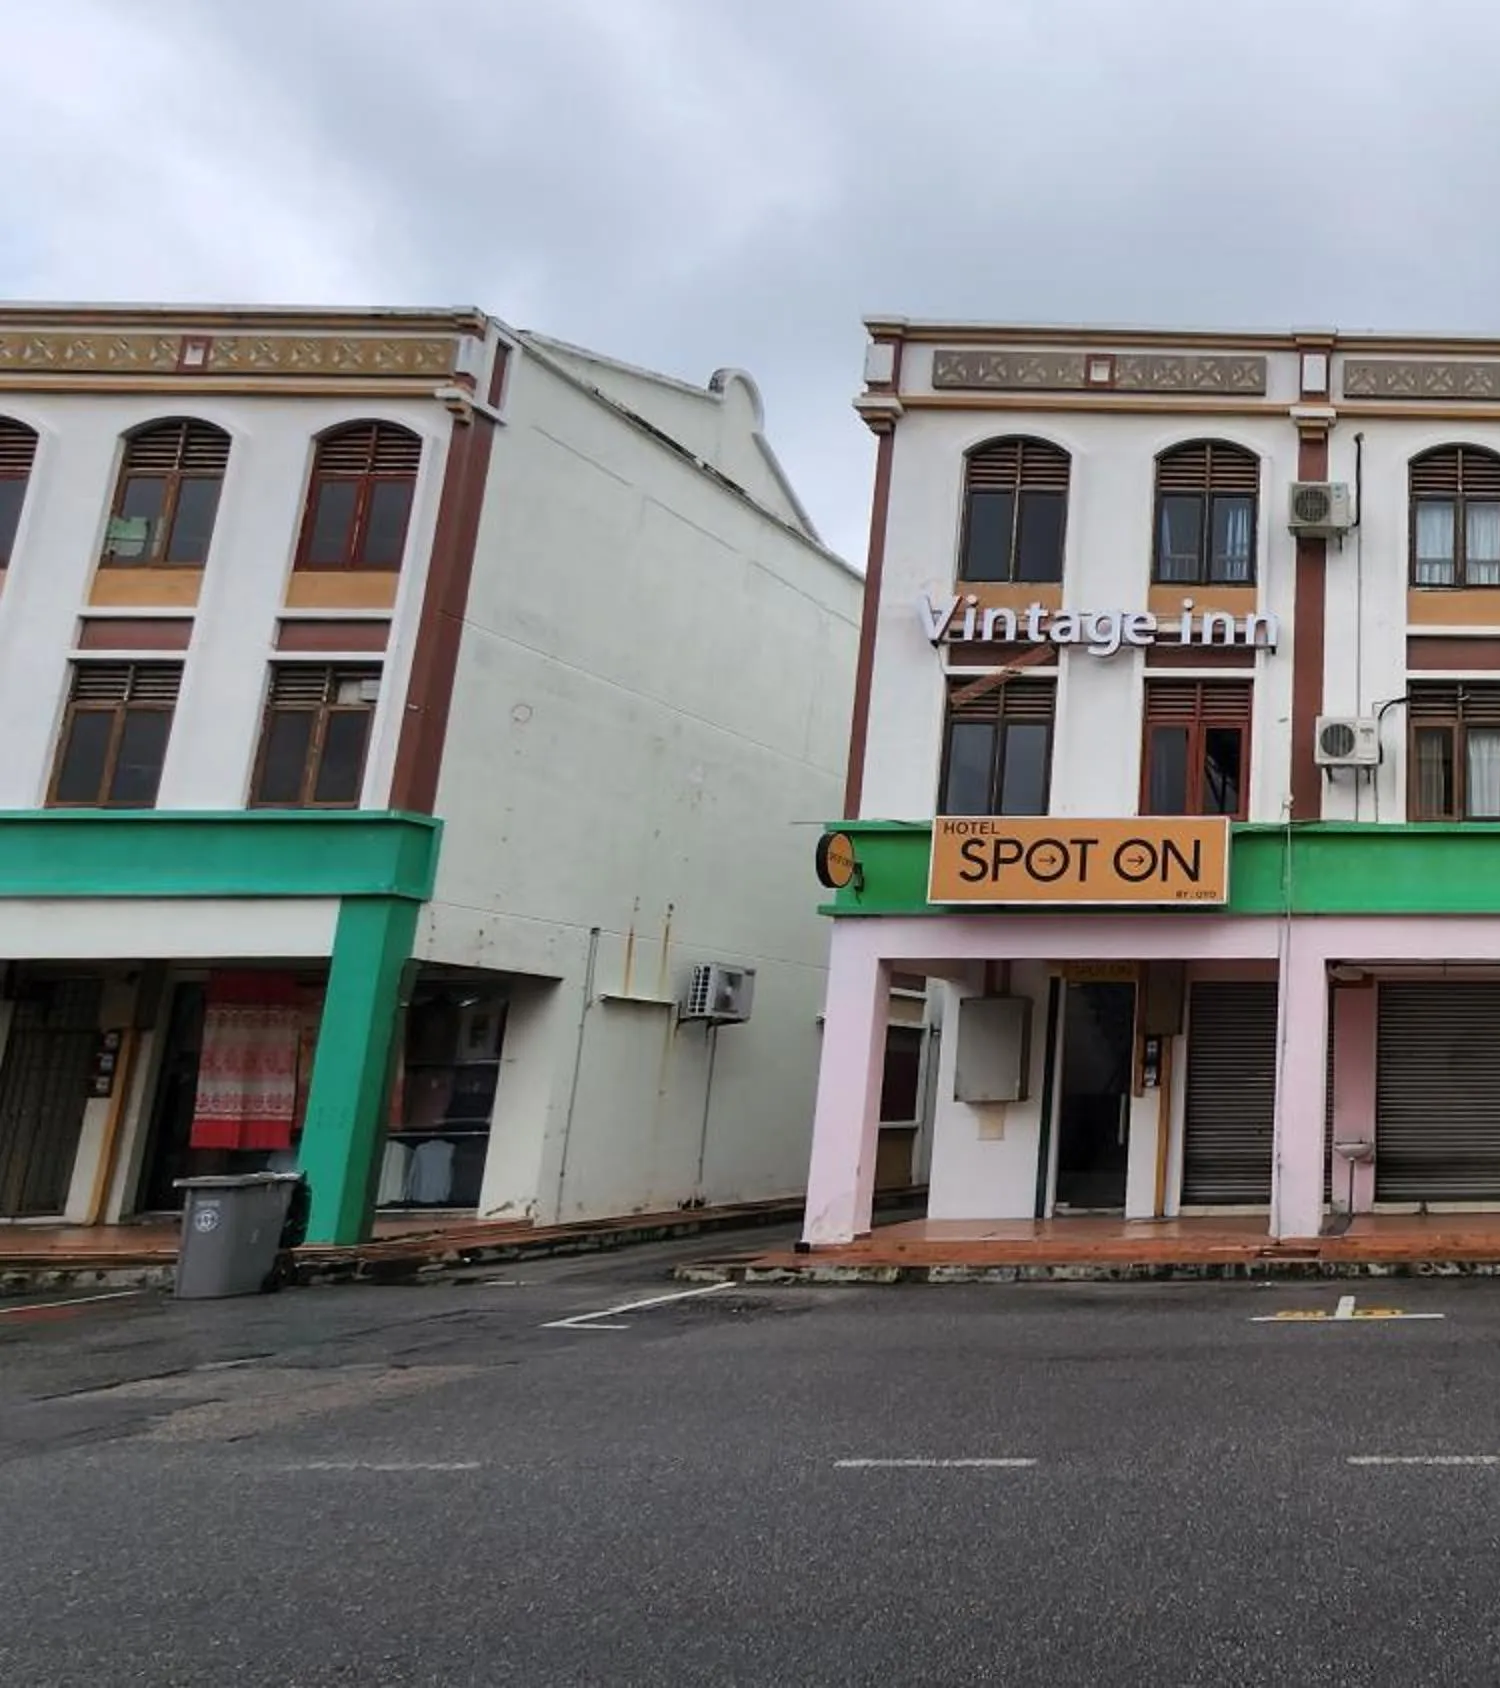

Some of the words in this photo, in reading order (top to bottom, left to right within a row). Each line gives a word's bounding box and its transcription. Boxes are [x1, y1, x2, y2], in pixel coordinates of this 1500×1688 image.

[918, 592, 1159, 657] Vintage
[1180, 597, 1281, 647] inn
[943, 821, 1000, 835] HOTEL
[958, 837, 1099, 883] SPOT
[1113, 838, 1201, 883] ON
